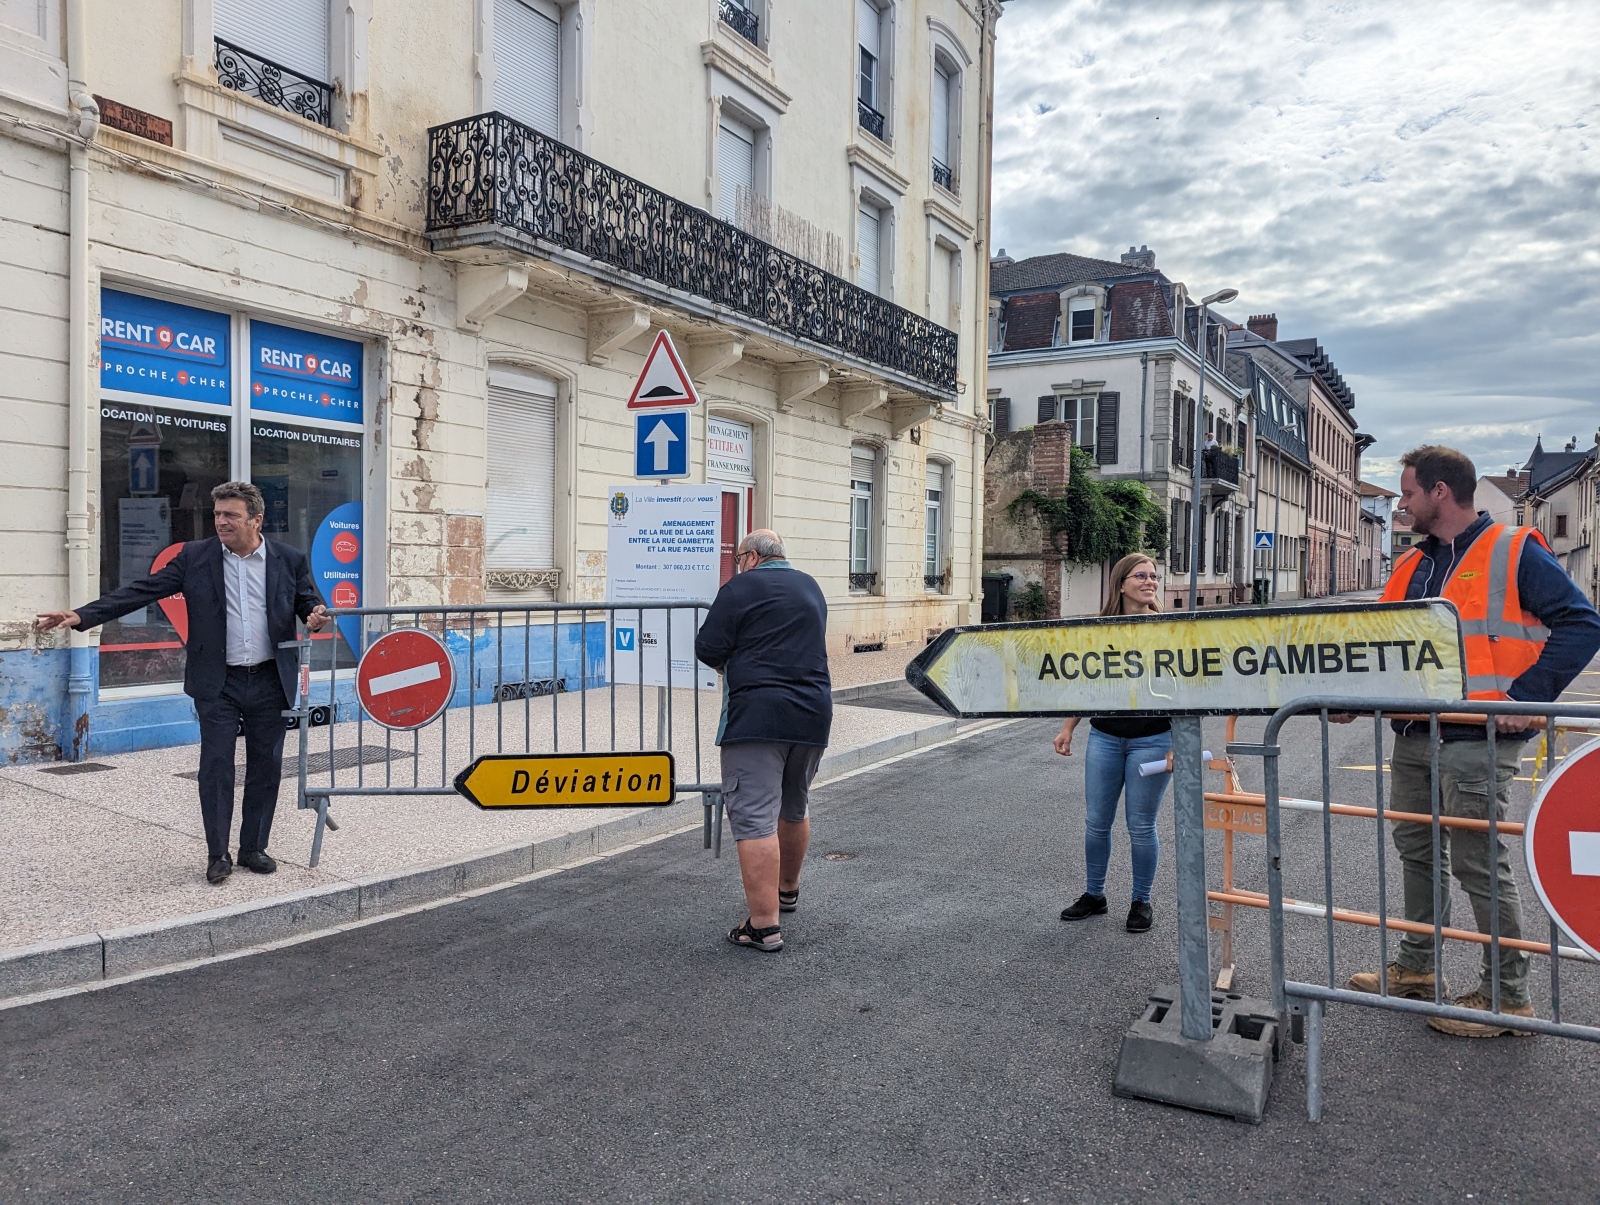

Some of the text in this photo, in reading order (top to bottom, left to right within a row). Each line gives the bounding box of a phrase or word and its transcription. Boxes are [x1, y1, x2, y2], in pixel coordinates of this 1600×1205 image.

[101, 318, 154, 343] RENT
[176, 332, 216, 355] CAR
[261, 347, 303, 370] RENT
[320, 359, 352, 379] CAR
[190, 375, 226, 389] CHER
[330, 397, 360, 409] CHER
[100, 408, 227, 432] OCATION DE VOITURES
[253, 426, 361, 448] LOCATION D'UTILITAIRES
[707, 459, 751, 473] TRANSEXPRESS
[656, 495, 682, 503] investit
[682, 496, 697, 504] pour
[329, 520, 360, 531] Voitures
[662, 518, 716, 527] AMÉNAGEMENT
[677, 537, 715, 545] GAMBETTA
[647, 545, 657, 553] ET
[323, 570, 359, 580] Utilitaires
[1038, 639, 1445, 681] ACCÈS RUE GAMBETTA
[511, 768, 662, 794] Déviation
[1207, 807, 1264, 827] COLAS
